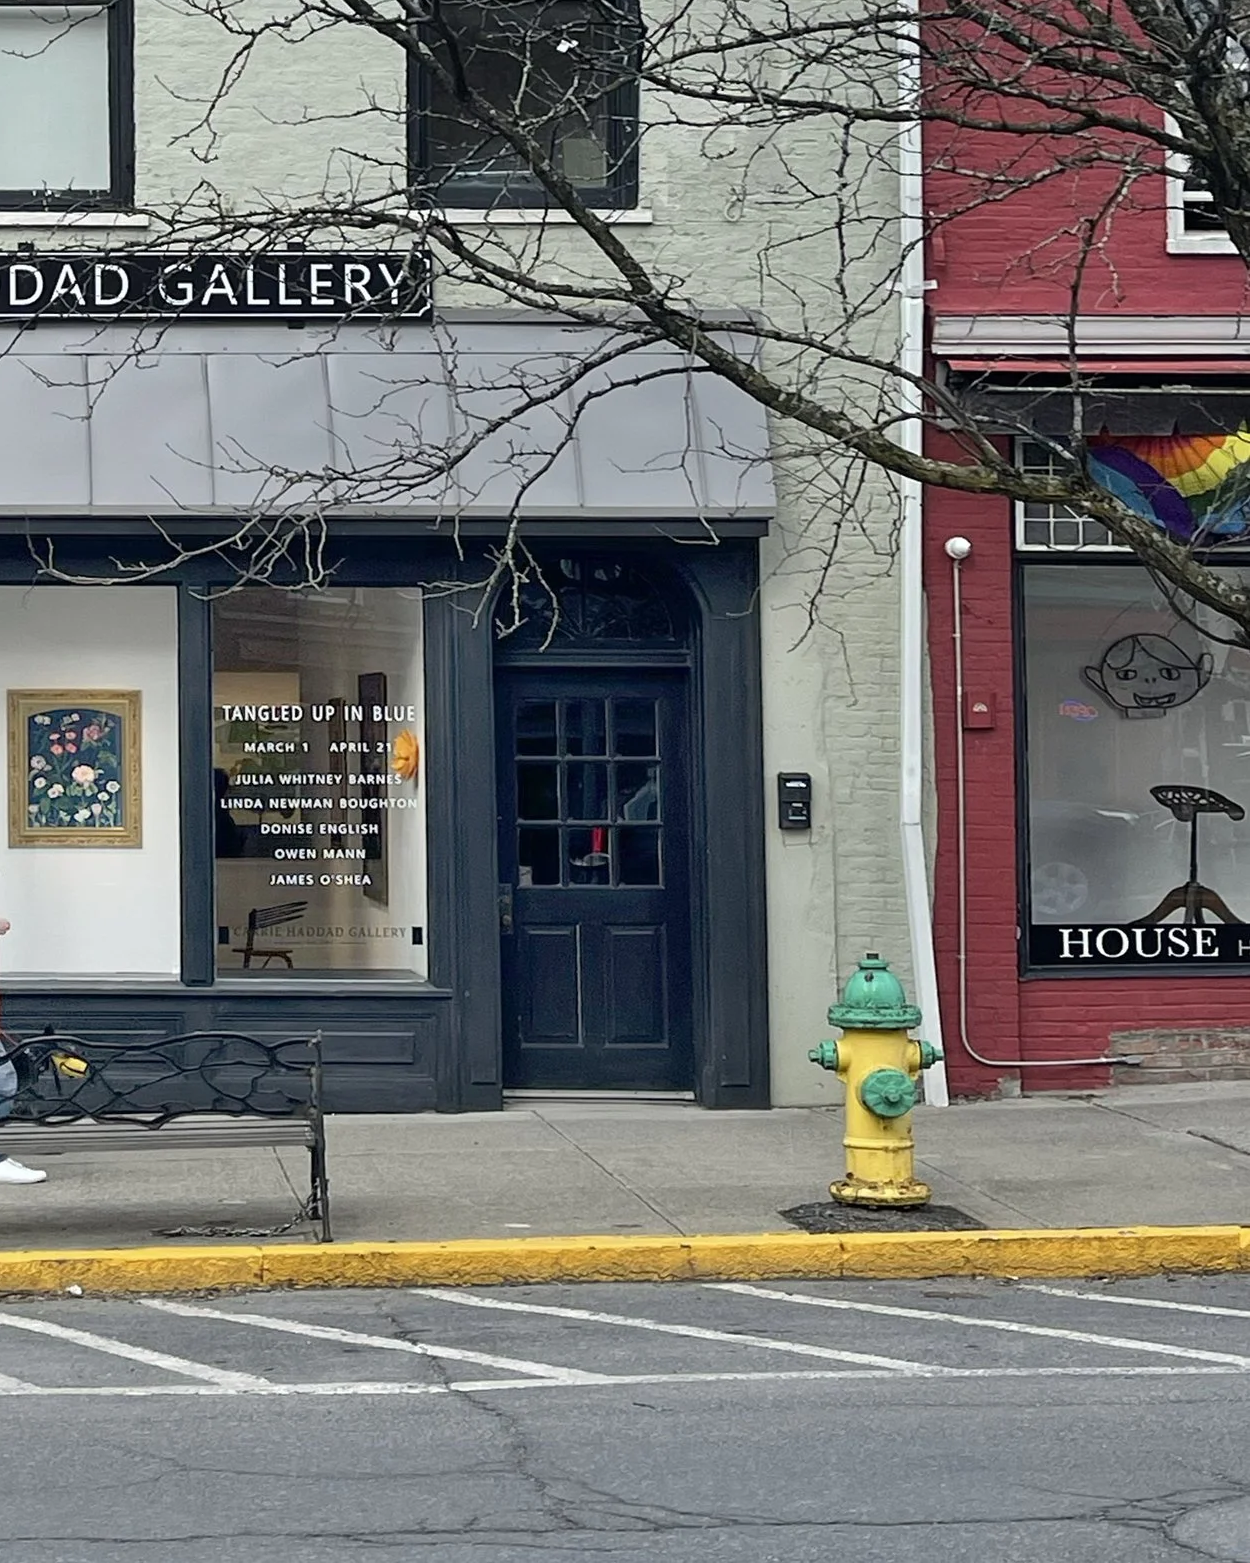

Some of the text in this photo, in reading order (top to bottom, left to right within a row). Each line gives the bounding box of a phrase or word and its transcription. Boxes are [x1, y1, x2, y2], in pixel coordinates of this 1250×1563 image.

[158, 263, 409, 306] GALLERY
[222, 705, 415, 721] TANGLED UP IN BLUE
[244, 742, 392, 753] MARCH 1 APRIL 21
[235, 774, 402, 785] JULIA WHITNEY BARNES
[220, 798, 417, 809] LINDA NEWMAN BOUGHTON
[261, 824, 378, 835] DONISE ENGLISH
[274, 849, 366, 860] OWEN MANN
[269, 874, 371, 886] JAMES O'SHEA
[234, 926, 406, 937] CRIE HADDAD GALLERY
[1059, 928, 1219, 958] HOUSE
